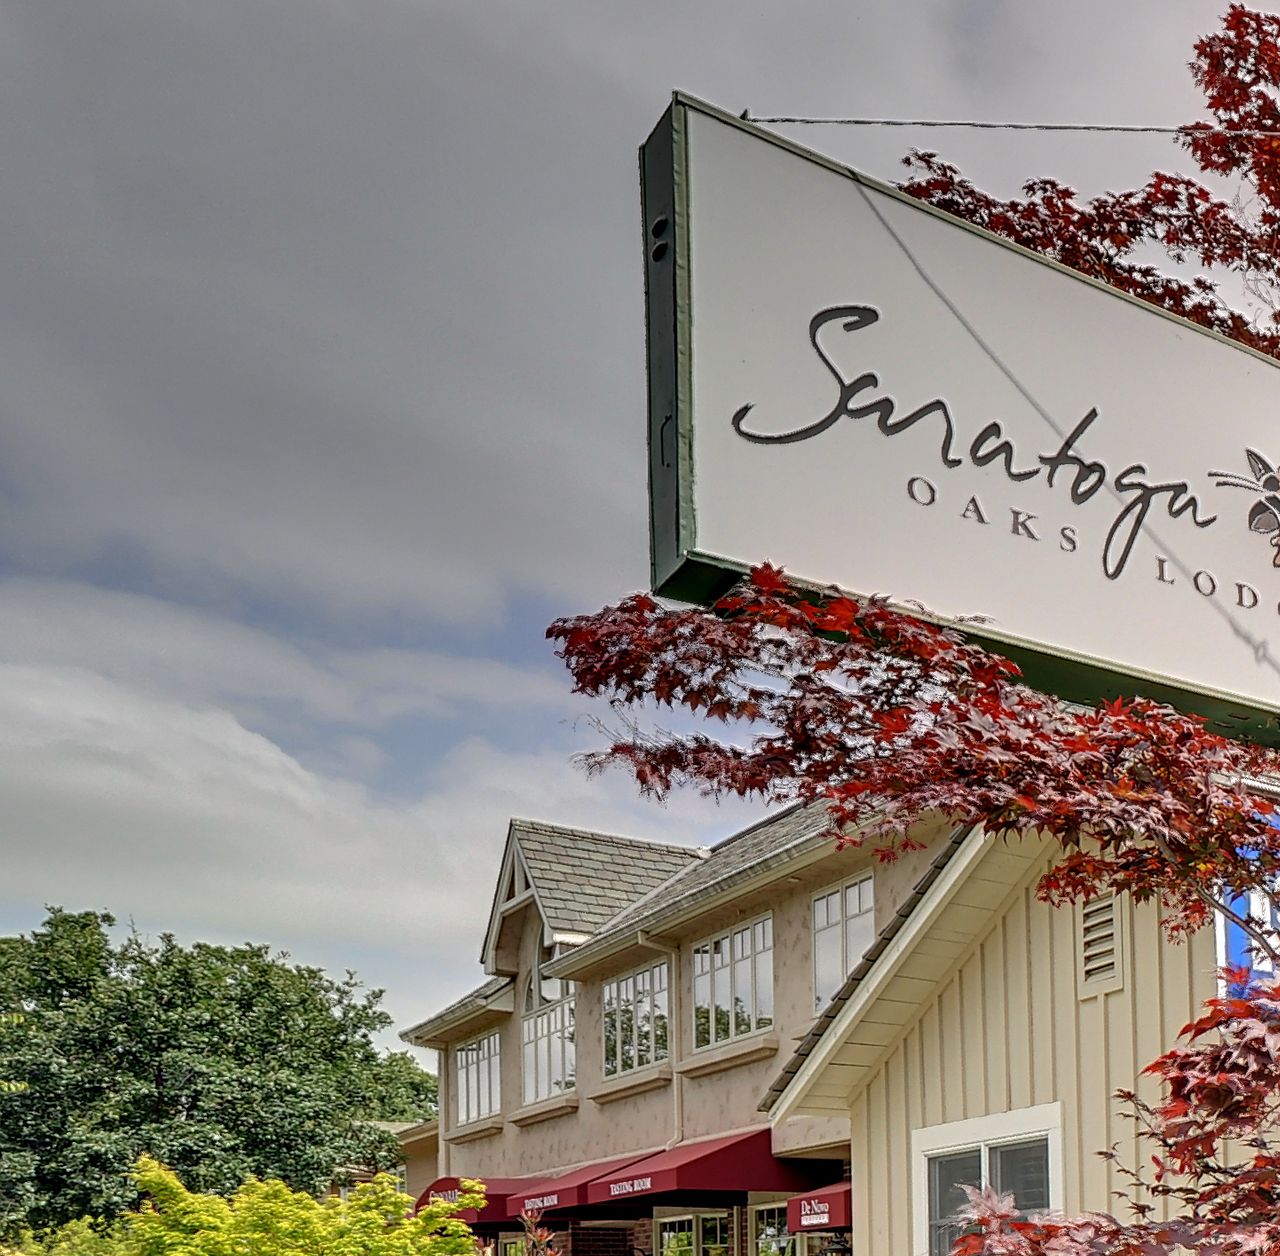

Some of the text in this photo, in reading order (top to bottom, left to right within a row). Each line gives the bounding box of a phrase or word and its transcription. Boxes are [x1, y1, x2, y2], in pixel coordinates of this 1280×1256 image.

[731, 304, 1217, 580] Saratoga
[906, 475, 1079, 553] OAKS
[610, 1177, 652, 1195] TASTING ROOM
